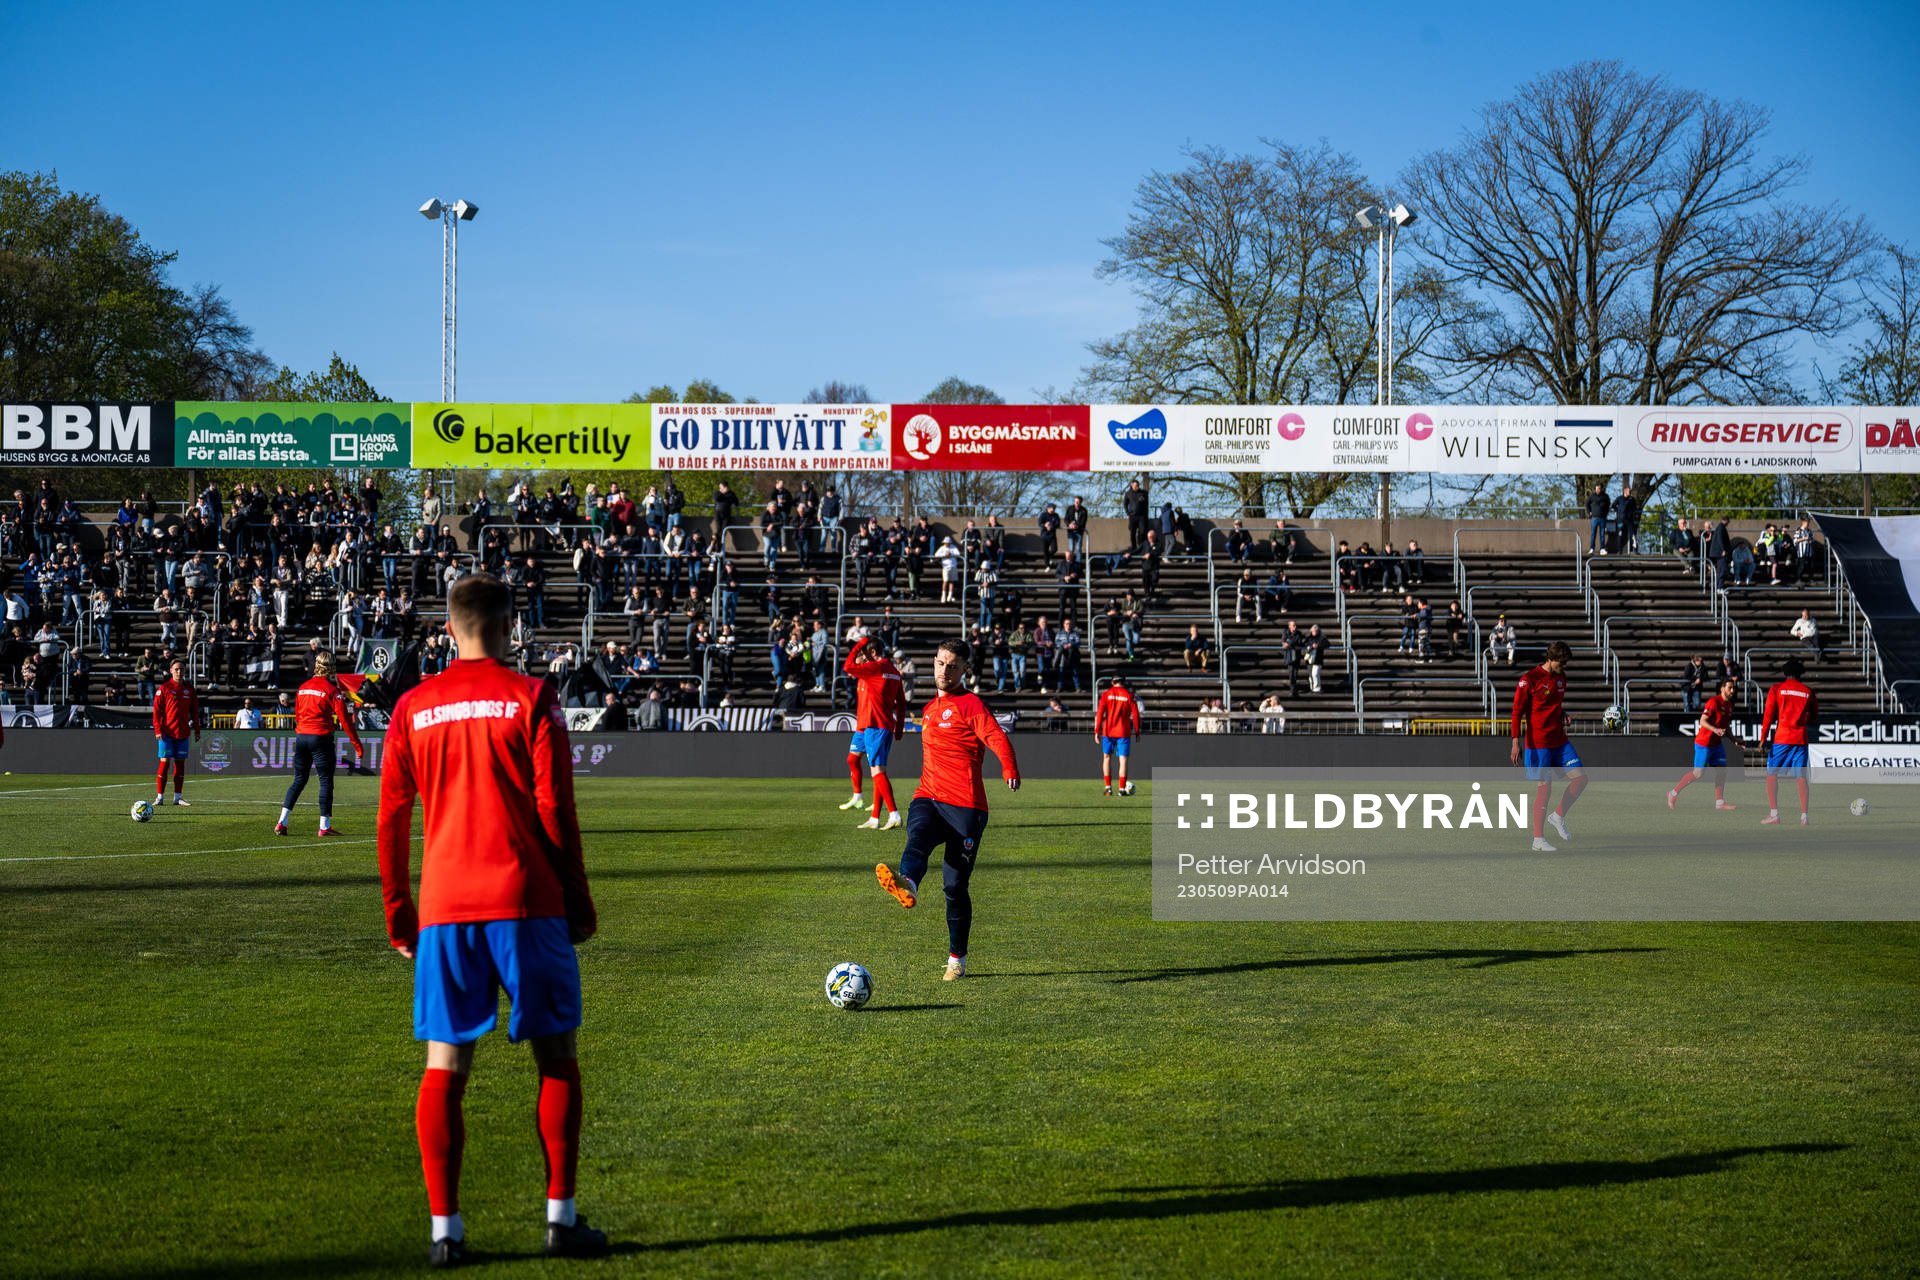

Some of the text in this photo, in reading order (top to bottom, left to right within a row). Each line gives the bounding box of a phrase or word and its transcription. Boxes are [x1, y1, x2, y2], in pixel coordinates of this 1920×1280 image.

[658, 407, 680, 415] BARA
[682, 407, 698, 415] HOS
[701, 407, 717, 415] OSS
[725, 407, 775, 415] SUPERFOAM!
[3, 405, 150, 450] BBM
[1205, 417, 1272, 436] COMFORT
[1333, 417, 1400, 436] COMFORT
[1442, 418, 1547, 428] ADVOKATFIRMAN
[360, 434, 396, 443] LANDS
[660, 414, 846, 450] GO BILTVÄTT
[1115, 428, 1162, 440] arema
[1651, 423, 1841, 443] RINGSERVICE
[1866, 418, 1920, 447] DÄ
[187, 430, 298, 449] Allmän nytta.
[474, 426, 631, 463] bakertilly
[1205, 440, 1270, 450] CARL-PHILIPS VVS
[1333, 440, 1398, 450] CARL-PHILIPS VVS
[187, 447, 214, 461] För
[217, 446, 256, 461] allas
[360, 443, 398, 452] KRONA
[955, 441, 992, 454] SKÅNE
[1441, 436, 1613, 459] WILENSKY
[0, 453, 150, 463] HUSENS BYGG & MONTAGE AB
[360, 452, 383, 461] HEM
[658, 456, 889, 470] NU BÅDE PÅ PJÄSGATAN & PUMPGATAN!
[1205, 454, 1261, 465] CENTRALVÄRME
[1333, 454, 1389, 465] CENTRALVÄRME
[1673, 457, 1817, 467] PUMPGATAN 6 LANDSKRONA
[504, 701, 520, 719] IF
[1818, 720, 1920, 742] stadium
